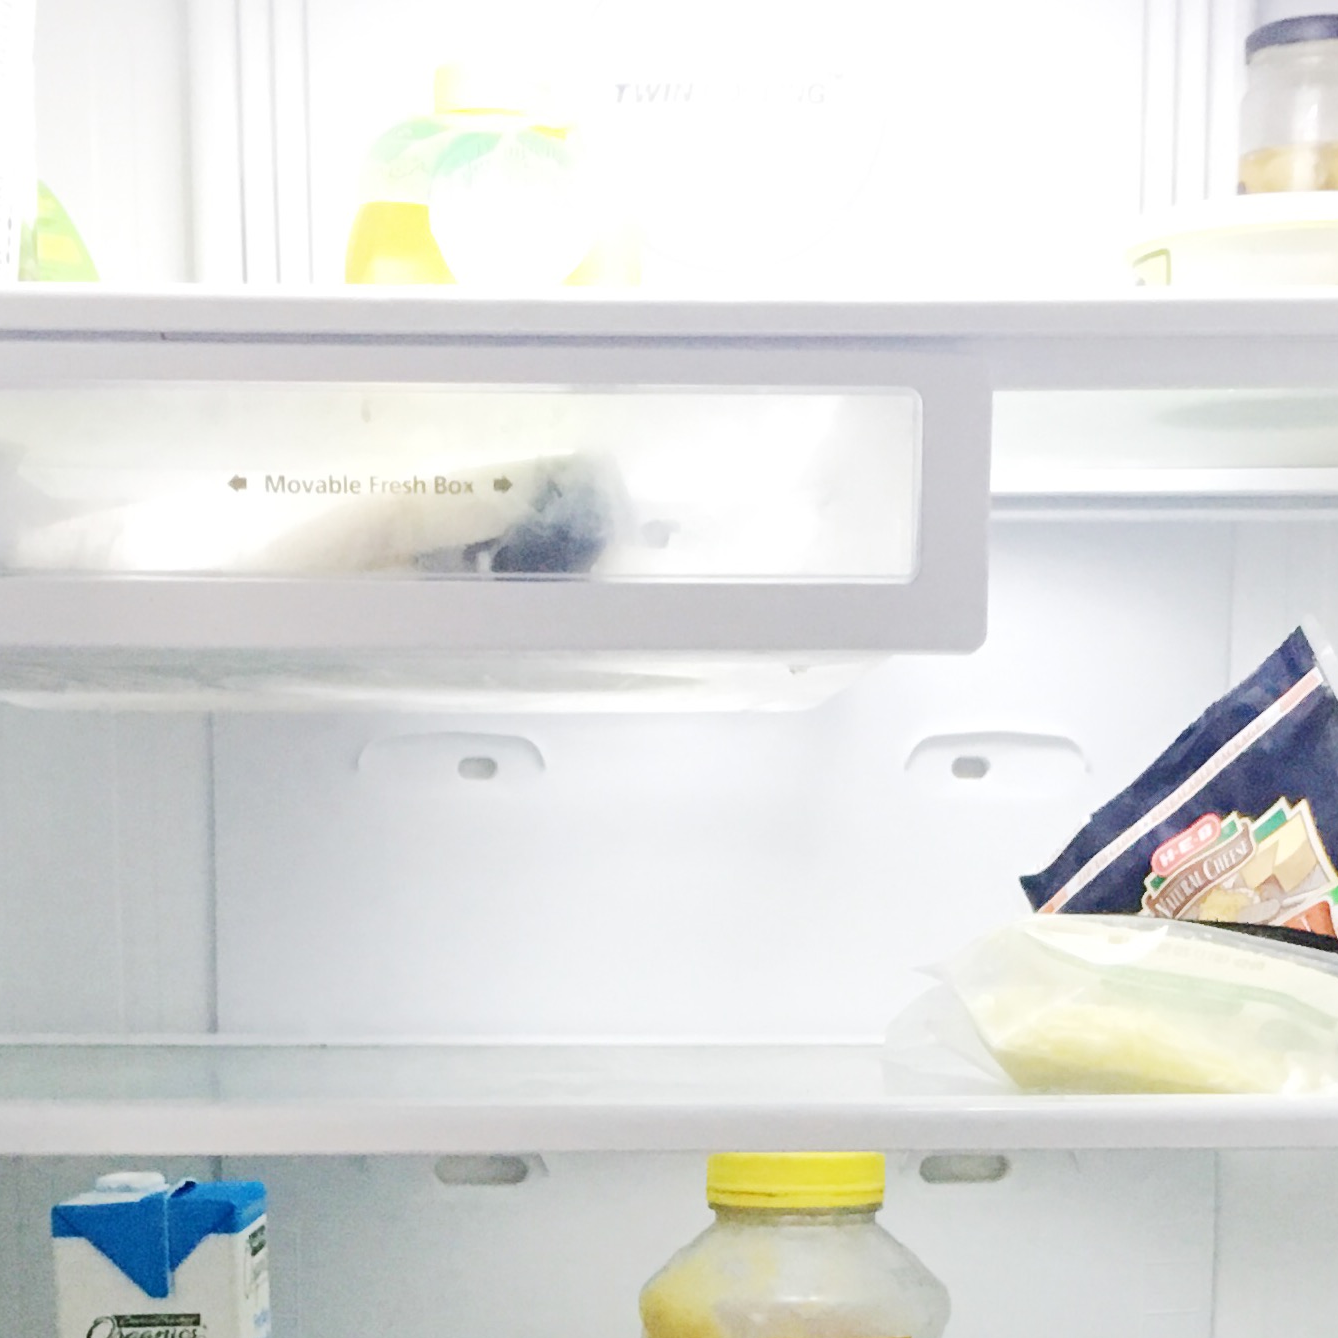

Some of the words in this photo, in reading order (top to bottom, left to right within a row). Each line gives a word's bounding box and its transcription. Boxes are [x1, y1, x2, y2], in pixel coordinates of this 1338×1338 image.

[264, 475, 361, 495] Movable
[369, 475, 426, 495] Fresh
[434, 475, 475, 495] Box
